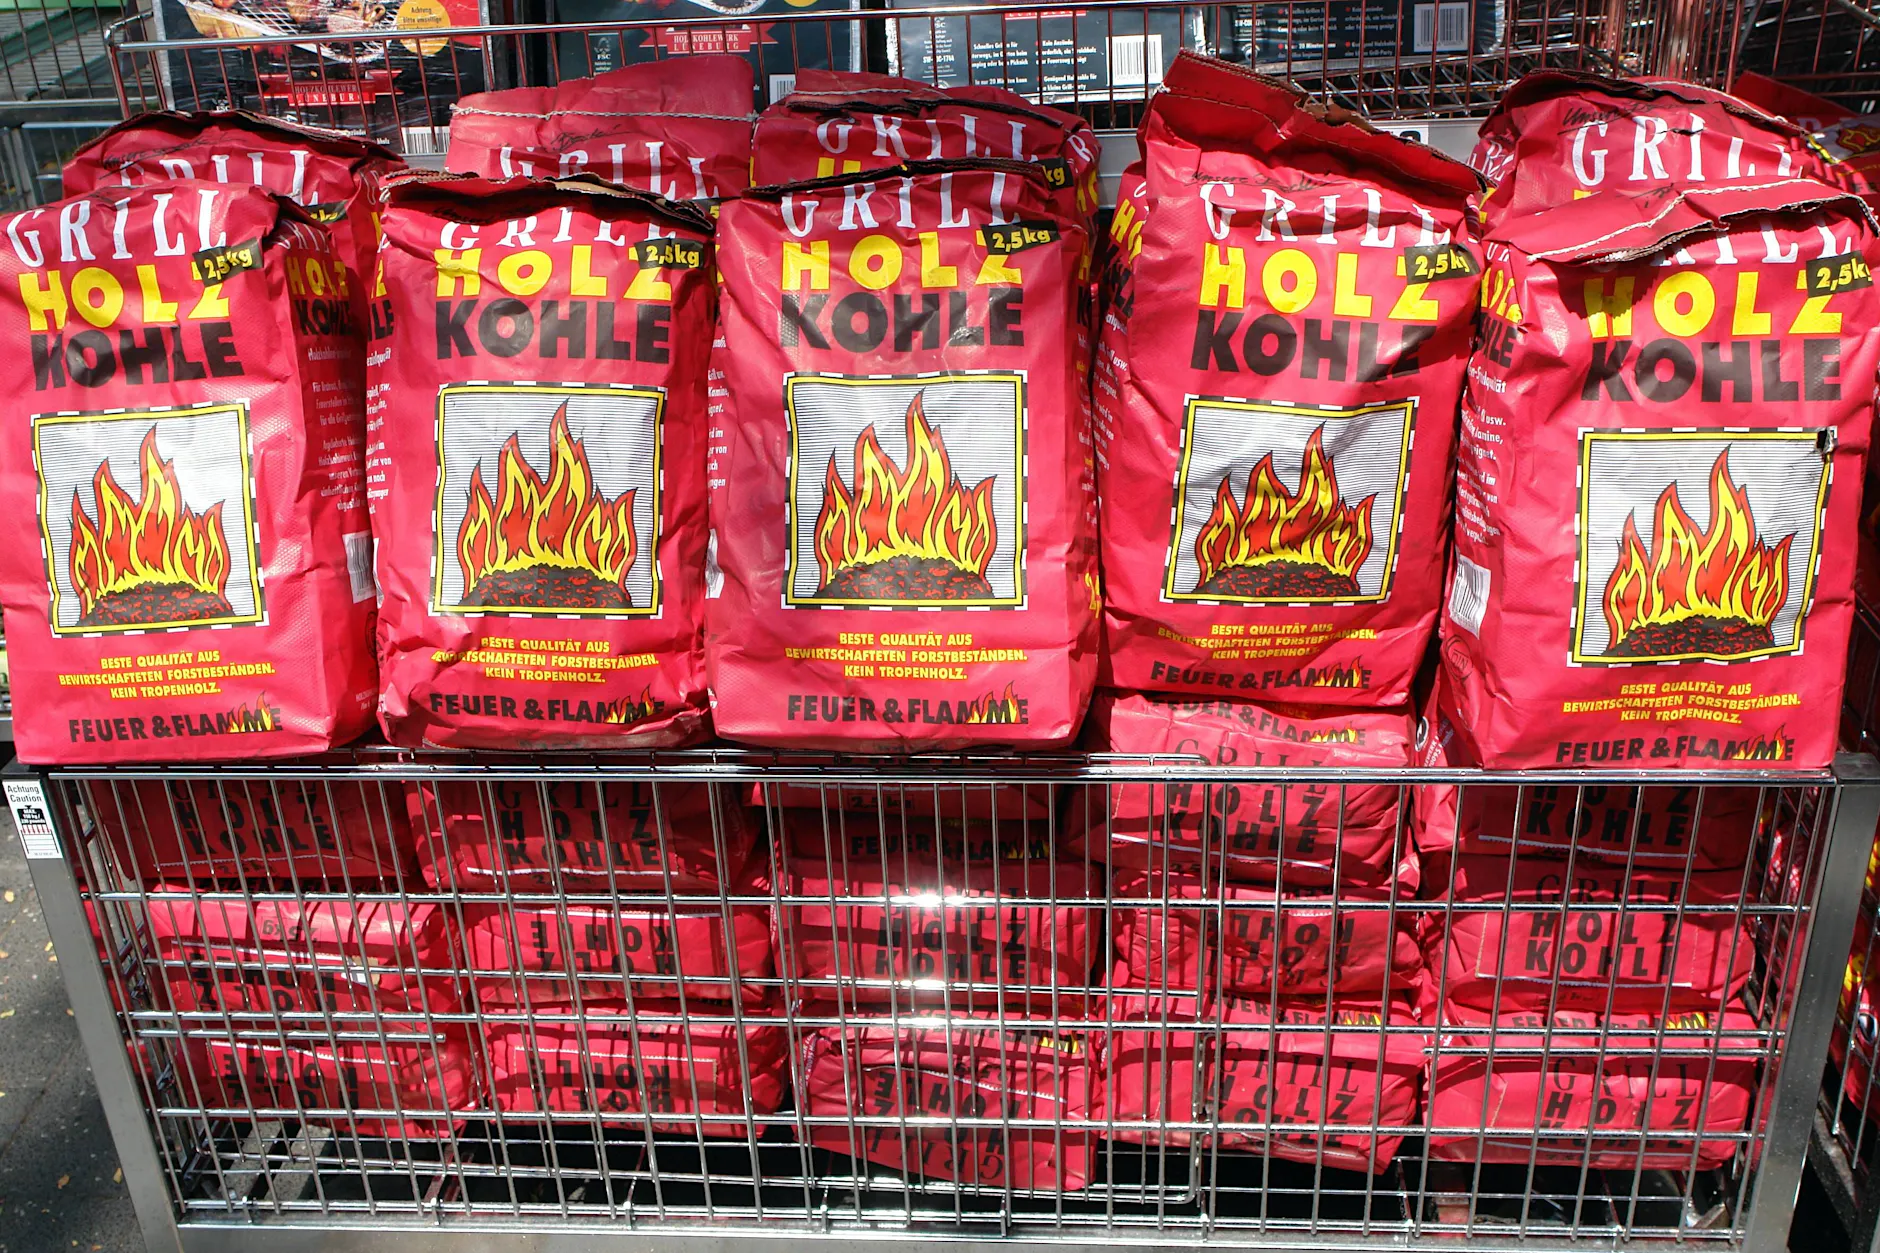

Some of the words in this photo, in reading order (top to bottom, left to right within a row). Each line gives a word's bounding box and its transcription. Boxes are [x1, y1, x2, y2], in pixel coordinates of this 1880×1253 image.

[674, 34, 739, 43] HOLKOHLEWRK
[817, 113, 1039, 163] GRILL
[1572, 112, 1802, 187] GRILL
[781, 171, 1021, 238] GRILL
[1200, 180, 1451, 249] GRILL
[6, 188, 227, 268] GRILL
[992, 228, 1051, 253] 2,5kg
[203, 249, 252, 281] 2,5kg
[645, 244, 700, 268] 2,5kg
[782, 231, 1022, 290] HOLZ
[434, 244, 672, 301] HOLZ
[1200, 242, 1440, 321] HOLZ
[18, 261, 230, 331] HOLZ
[1583, 270, 1844, 339] HOLZ
[435, 298, 672, 364] KOHLE
[780, 286, 1026, 354] KOHLE
[30, 321, 246, 391] KOHLE
[1189, 308, 1440, 384] KOHLE
[1580, 336, 1842, 403] KOHLE
[840, 632, 874, 646] BESTE
[880, 631, 942, 647] QUALITÄT
[946, 633, 973, 646] AUS
[1211, 624, 1245, 636] BESTE
[1249, 622, 1306, 637] QUALITÄT
[1310, 623, 1333, 633] AUS
[481, 636, 514, 649] BESTE
[519, 637, 581, 653] QUALITÄT
[586, 641, 610, 653] AUS
[785, 647, 906, 663] BEWIRTSCHAFTETEN
[911, 645, 1028, 663] FORSTBESTÄNDEN.
[1211, 649, 1240, 660] KEIN
[100, 655, 132, 670] BESTE
[136, 650, 194, 667] QUALITÄT
[197, 650, 220, 664] AUS
[551, 653, 660, 670] FORSTBESTÄNDEN.
[844, 665, 874, 678] KEIN
[879, 665, 967, 681] TROPENHOLZ.
[58, 669, 164, 687] BEWIRTSCHAFTETEN
[167, 661, 276, 681] FORSTBESTÄNDEN.
[485, 666, 515, 679] KEIN
[518, 669, 606, 684] TROPENHOLZ.
[1150, 660, 1234, 690] FEUER
[1620, 684, 1656, 695] BESTE
[1660, 680, 1725, 695] QUALITÄT
[1728, 682, 1752, 695] AUS
[110, 685, 137, 700] KEIN
[140, 682, 222, 699] TROPENHOLZ.
[1562, 694, 1683, 713] BEWIRTSCHAFTETEN
[1687, 693, 1802, 711] FORSTBESTÄNDEN.
[428, 692, 517, 721] FEUER
[787, 694, 876, 723] FEUER
[1620, 710, 1652, 722] KEIN
[1655, 708, 1743, 725] TROPENHOLZ.
[69, 717, 148, 743] FEUER
[1555, 737, 1645, 763] FEUER
[7, 784, 40, 794] Achtung
[9, 794, 42, 803] Caution
[1525, 801, 1688, 847] KOHLE
[875, 950, 1027, 979] KOHLE
